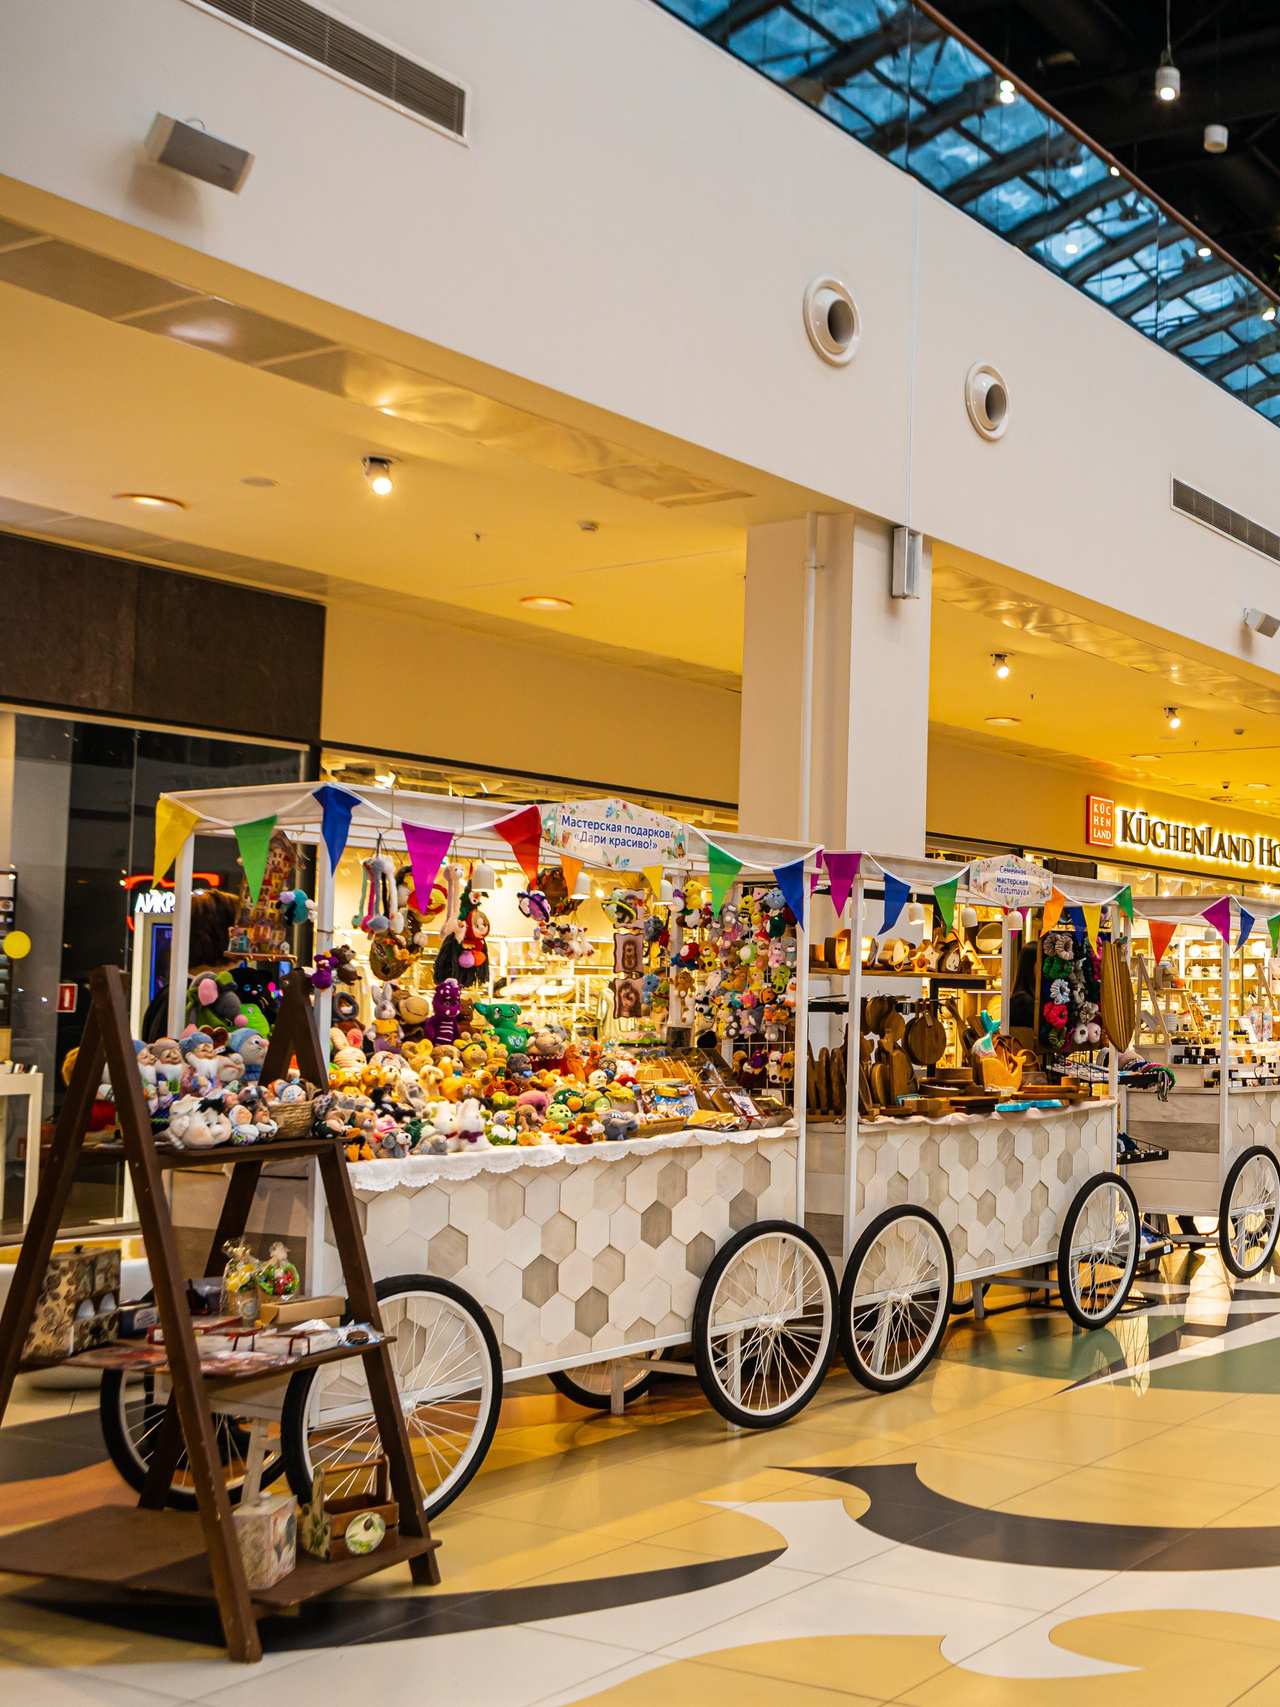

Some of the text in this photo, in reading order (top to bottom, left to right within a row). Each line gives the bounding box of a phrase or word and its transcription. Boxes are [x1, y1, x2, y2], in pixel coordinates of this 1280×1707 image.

[561, 814, 670, 839] Мастерская подарков
[1093, 816, 1111, 828] HEN
[574, 830, 658, 850] «Дари красиво!»
[1093, 829, 1112, 840] LAND
[999, 865, 1027, 876] Семейная
[996, 876, 1029, 887] мастерская
